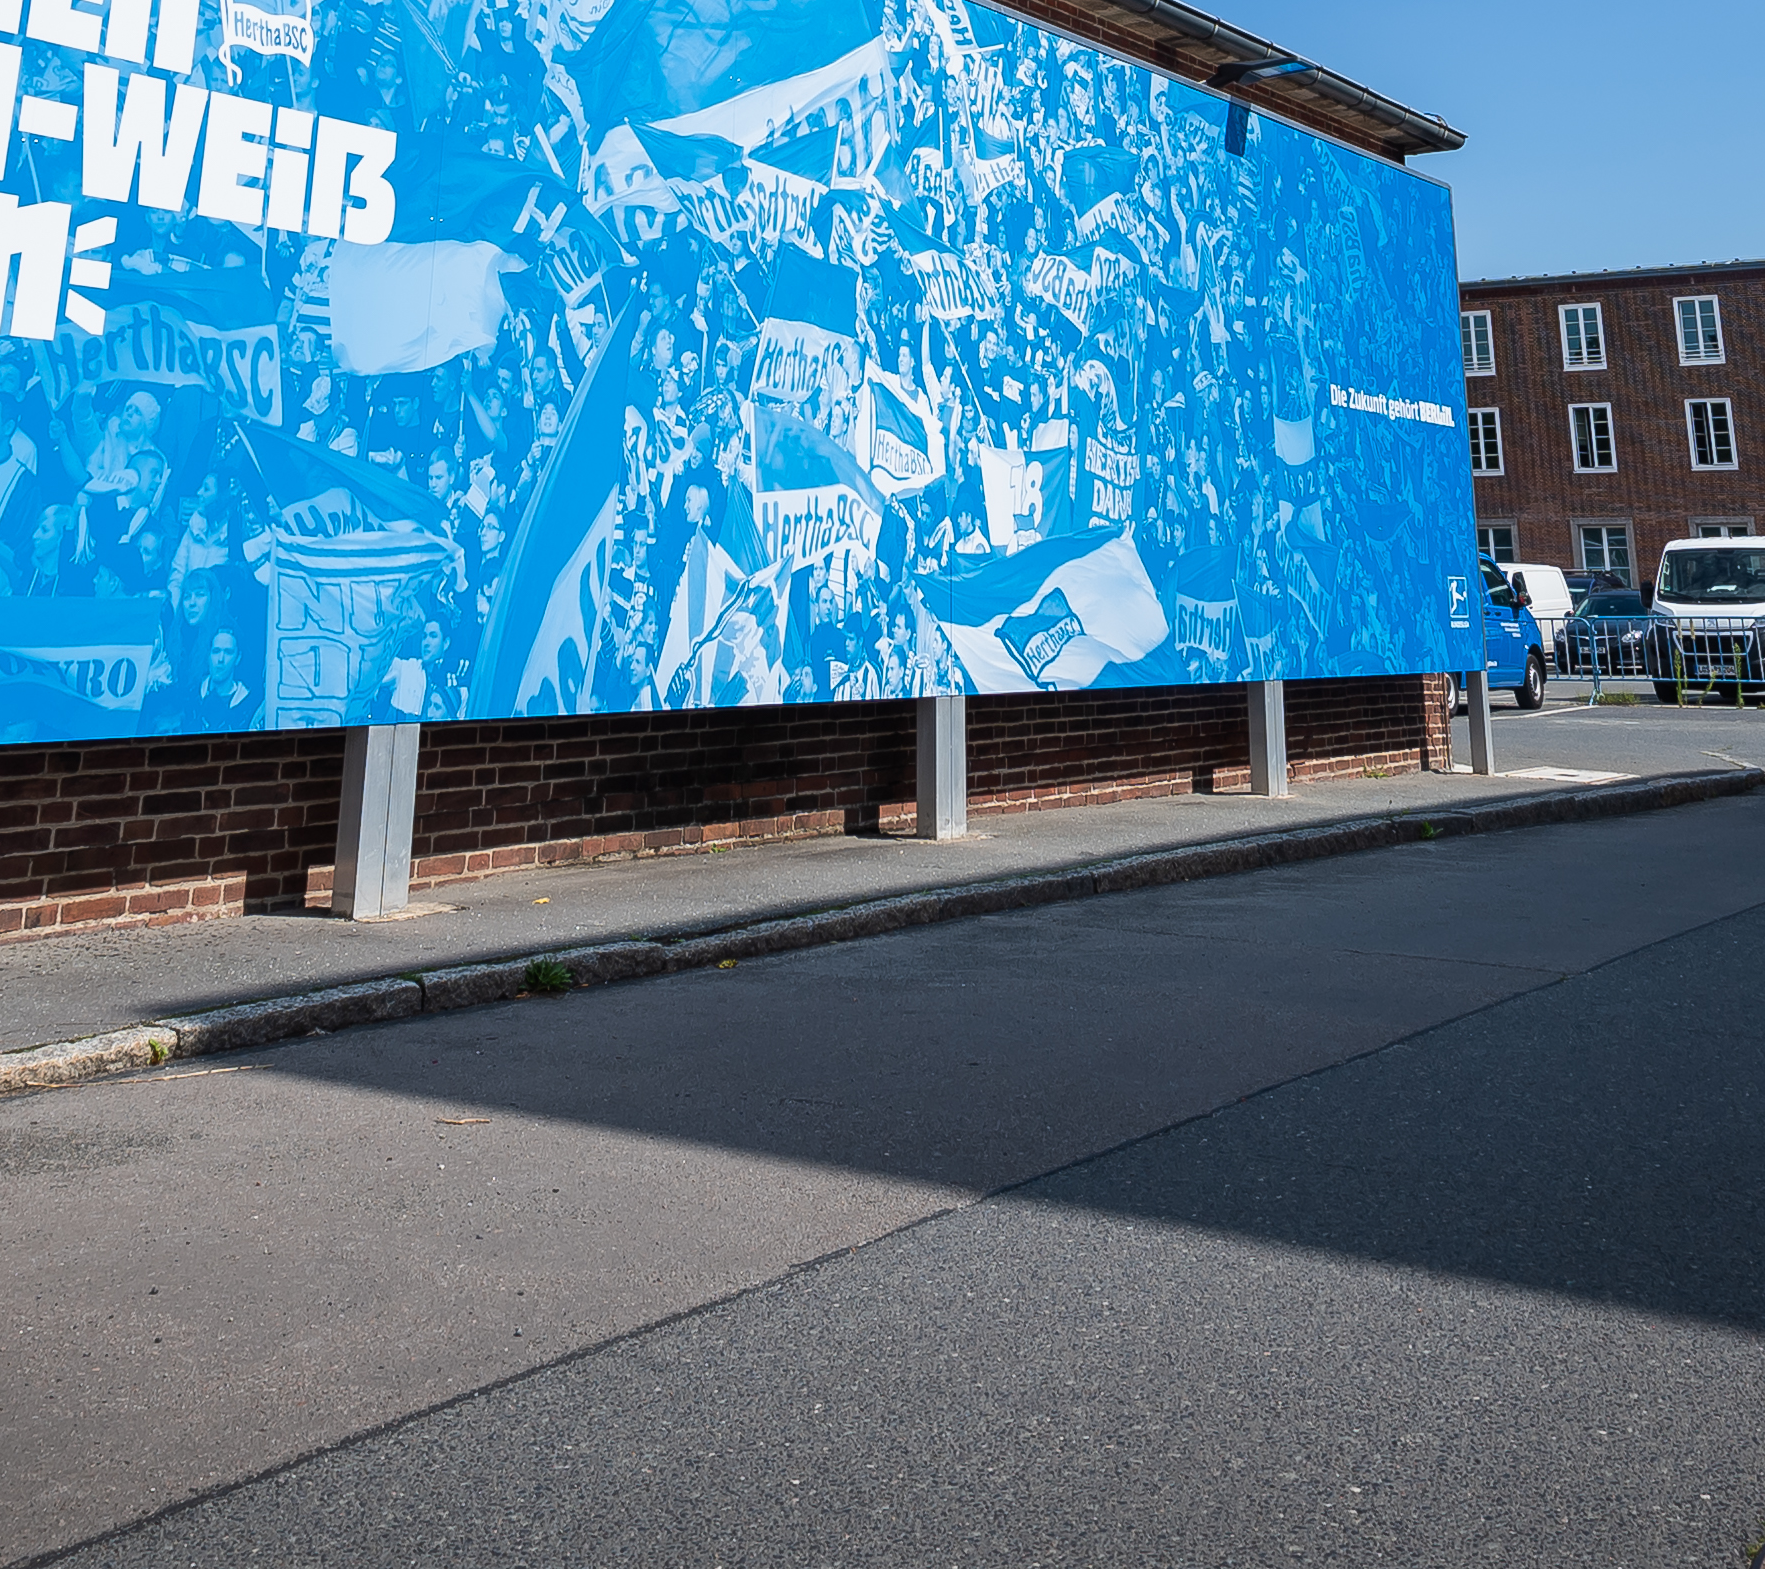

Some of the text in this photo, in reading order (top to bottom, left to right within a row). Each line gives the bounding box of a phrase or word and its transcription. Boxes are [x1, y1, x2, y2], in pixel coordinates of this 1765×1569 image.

[1330, 384, 1347, 407] Die
[1348, 387, 1388, 415] Zukunft
[1388, 397, 1419, 420] gehört
